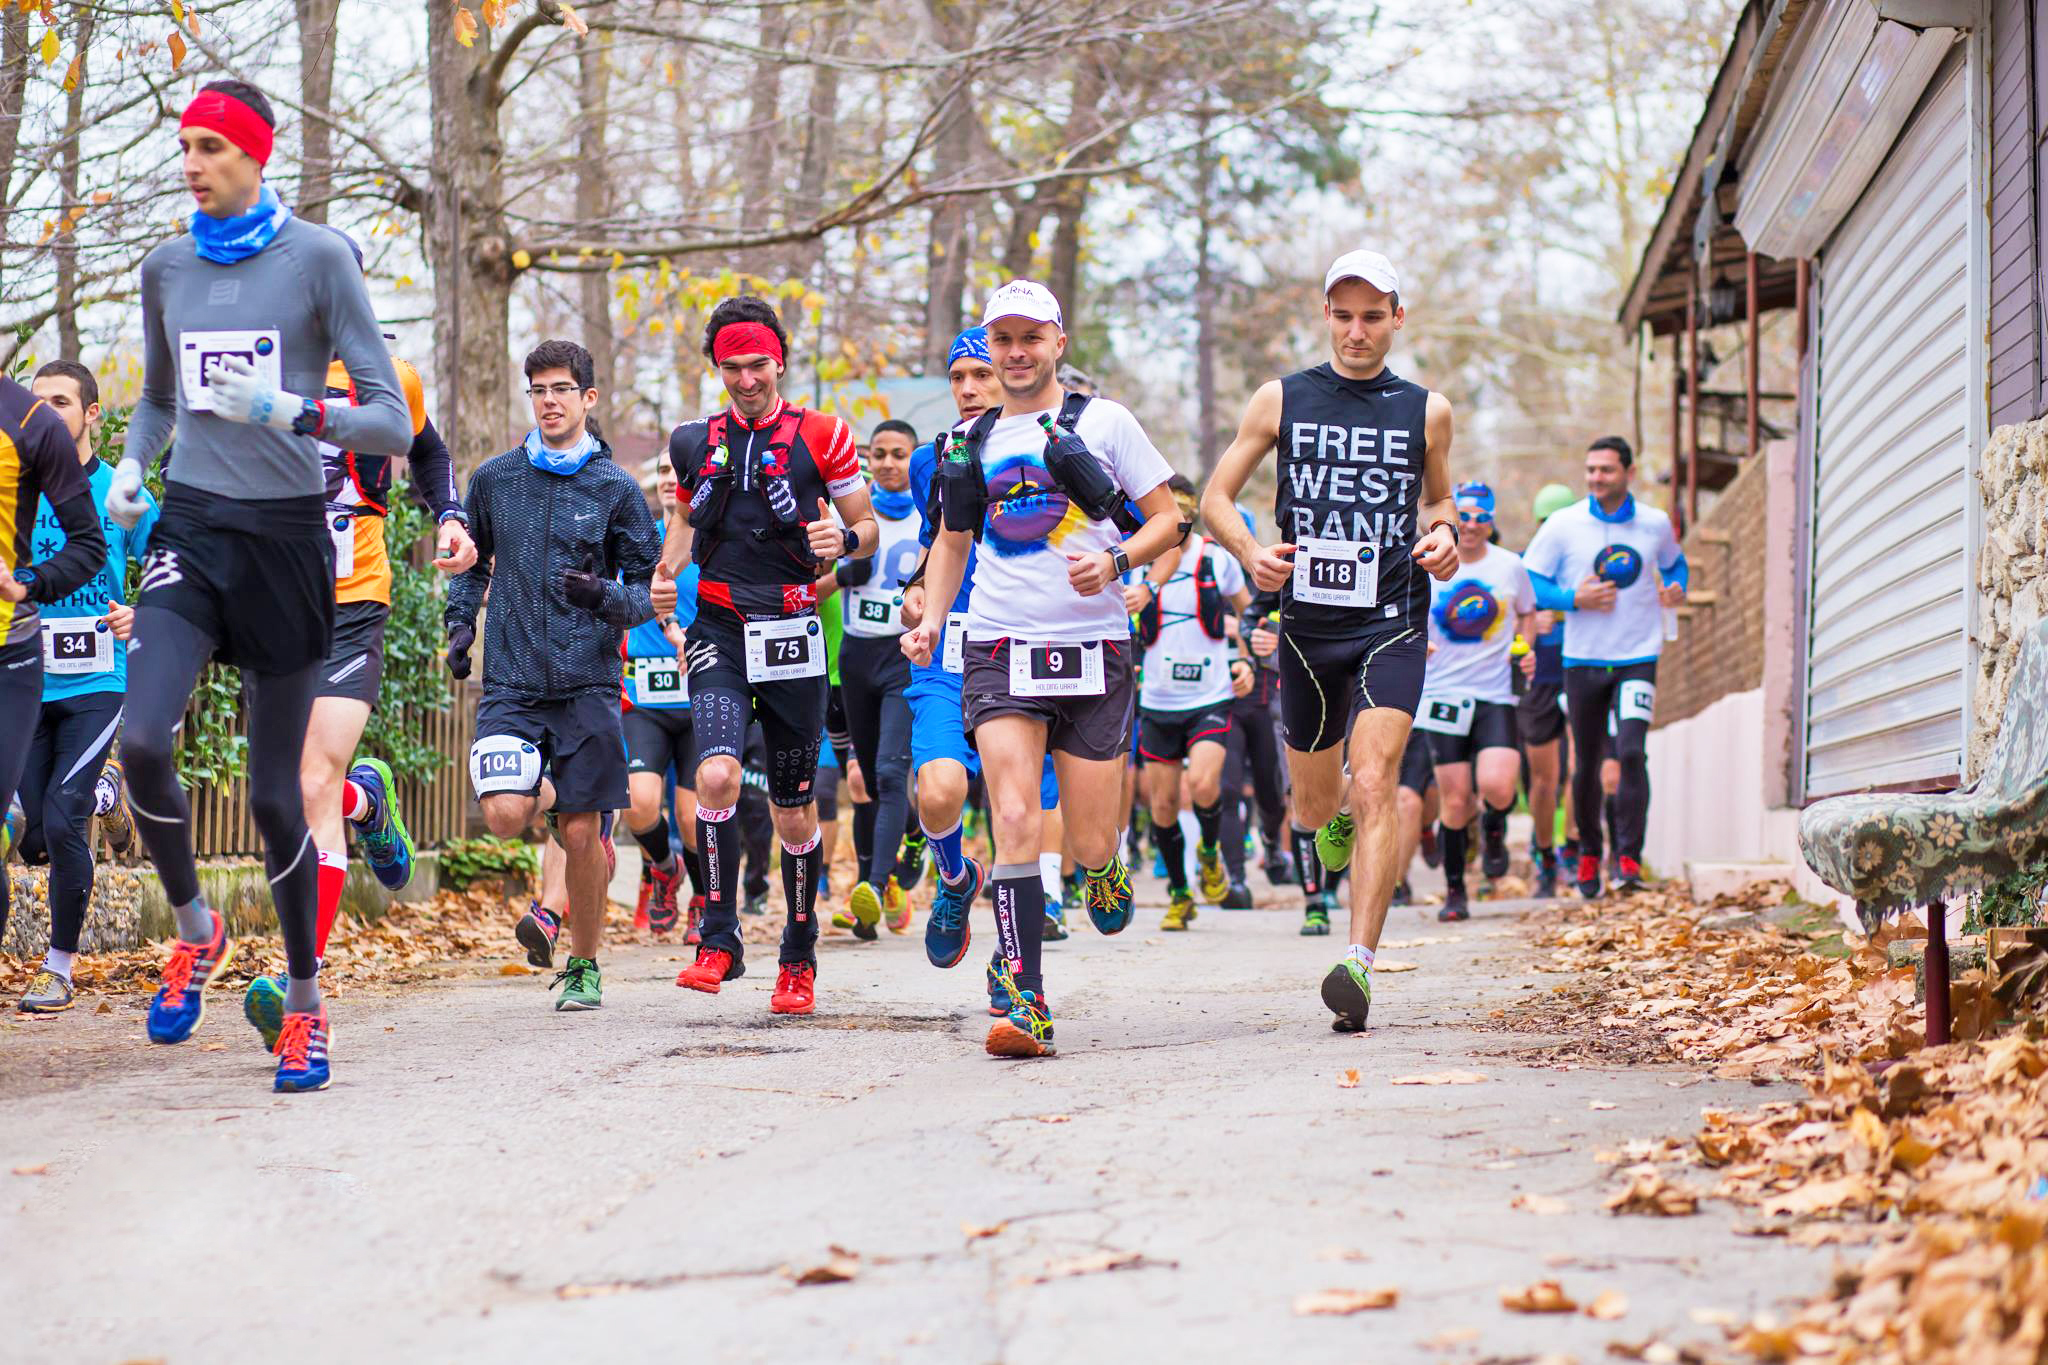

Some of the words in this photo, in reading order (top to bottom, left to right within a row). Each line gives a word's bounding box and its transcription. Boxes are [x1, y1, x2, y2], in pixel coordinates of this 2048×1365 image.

[1292, 422, 1410, 465] FREE
[1289, 463, 1416, 505] WEST
[1291, 506, 1409, 548] BANK
[1314, 562, 1351, 584] 118
[864, 602, 884, 619] 38
[62, 635, 87, 653] 34
[775, 641, 800, 660] 75
[1049, 651, 1063, 672] 9
[654, 673, 673, 688] 30
[1174, 665, 1201, 679] 507
[1438, 705, 1450, 719] 2
[483, 754, 518, 773] 104
